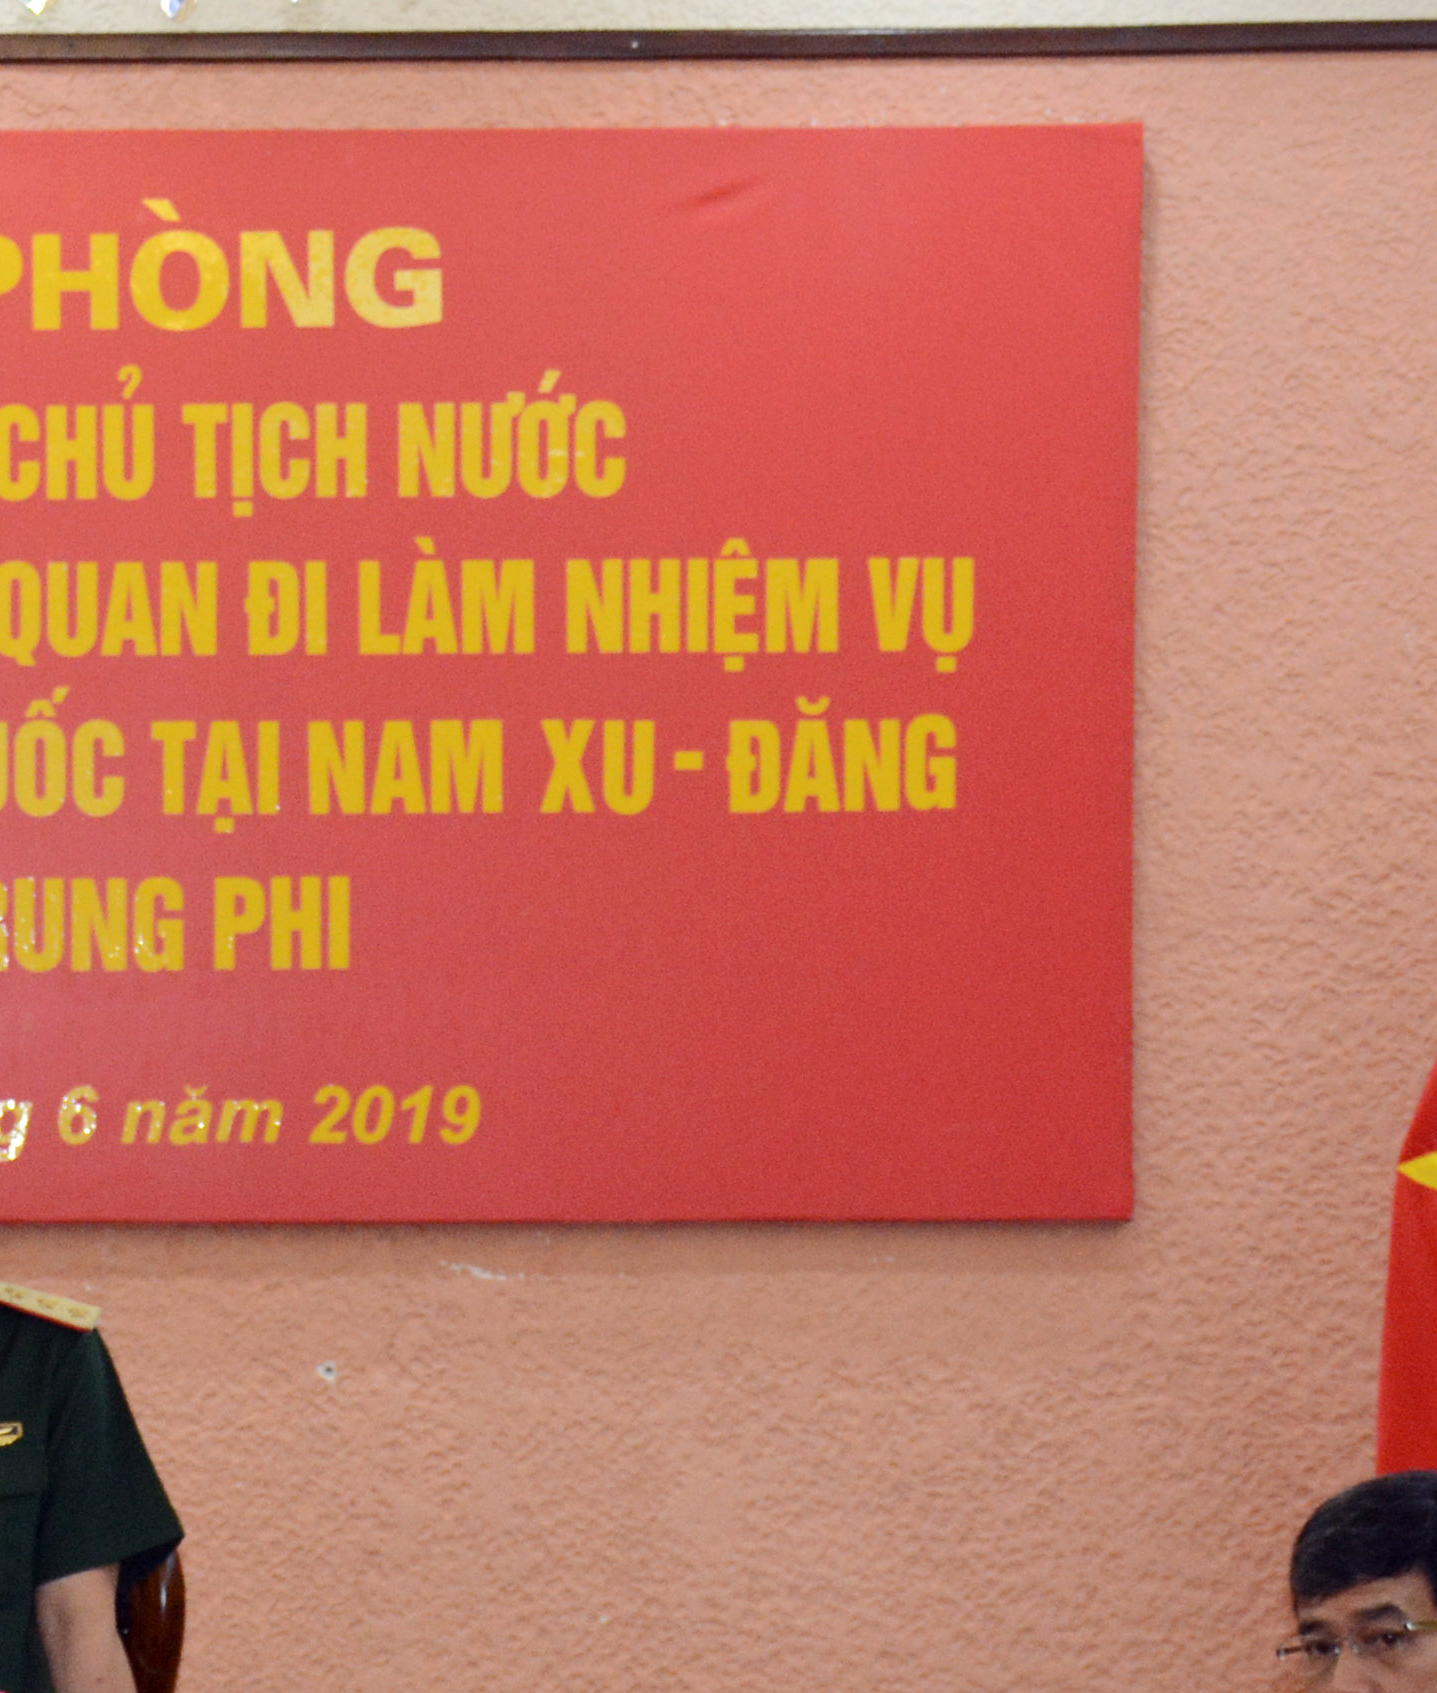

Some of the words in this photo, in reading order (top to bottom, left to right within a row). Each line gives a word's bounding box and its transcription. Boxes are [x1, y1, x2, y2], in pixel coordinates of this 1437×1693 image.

[182, 401, 368, 518] TỊCH
[398, 368, 626, 499] NƯỚC
[244, 560, 327, 656] ĐI
[358, 536, 535, 655] LÀM
[566, 538, 839, 672] NHIỆM
[868, 557, 974, 672] VỤ
[151, 720, 280, 833] TẠI
[307, 719, 503, 815] NAM
[540, 719, 655, 815] XU
[674, 749, 703, 771] -
[726, 696, 956, 813] ĐĂNG
[214, 875, 350, 970] PHI
[58, 1086, 98, 1145] 6
[121, 1085, 283, 1145] năm
[310, 1085, 481, 1144] 2019
